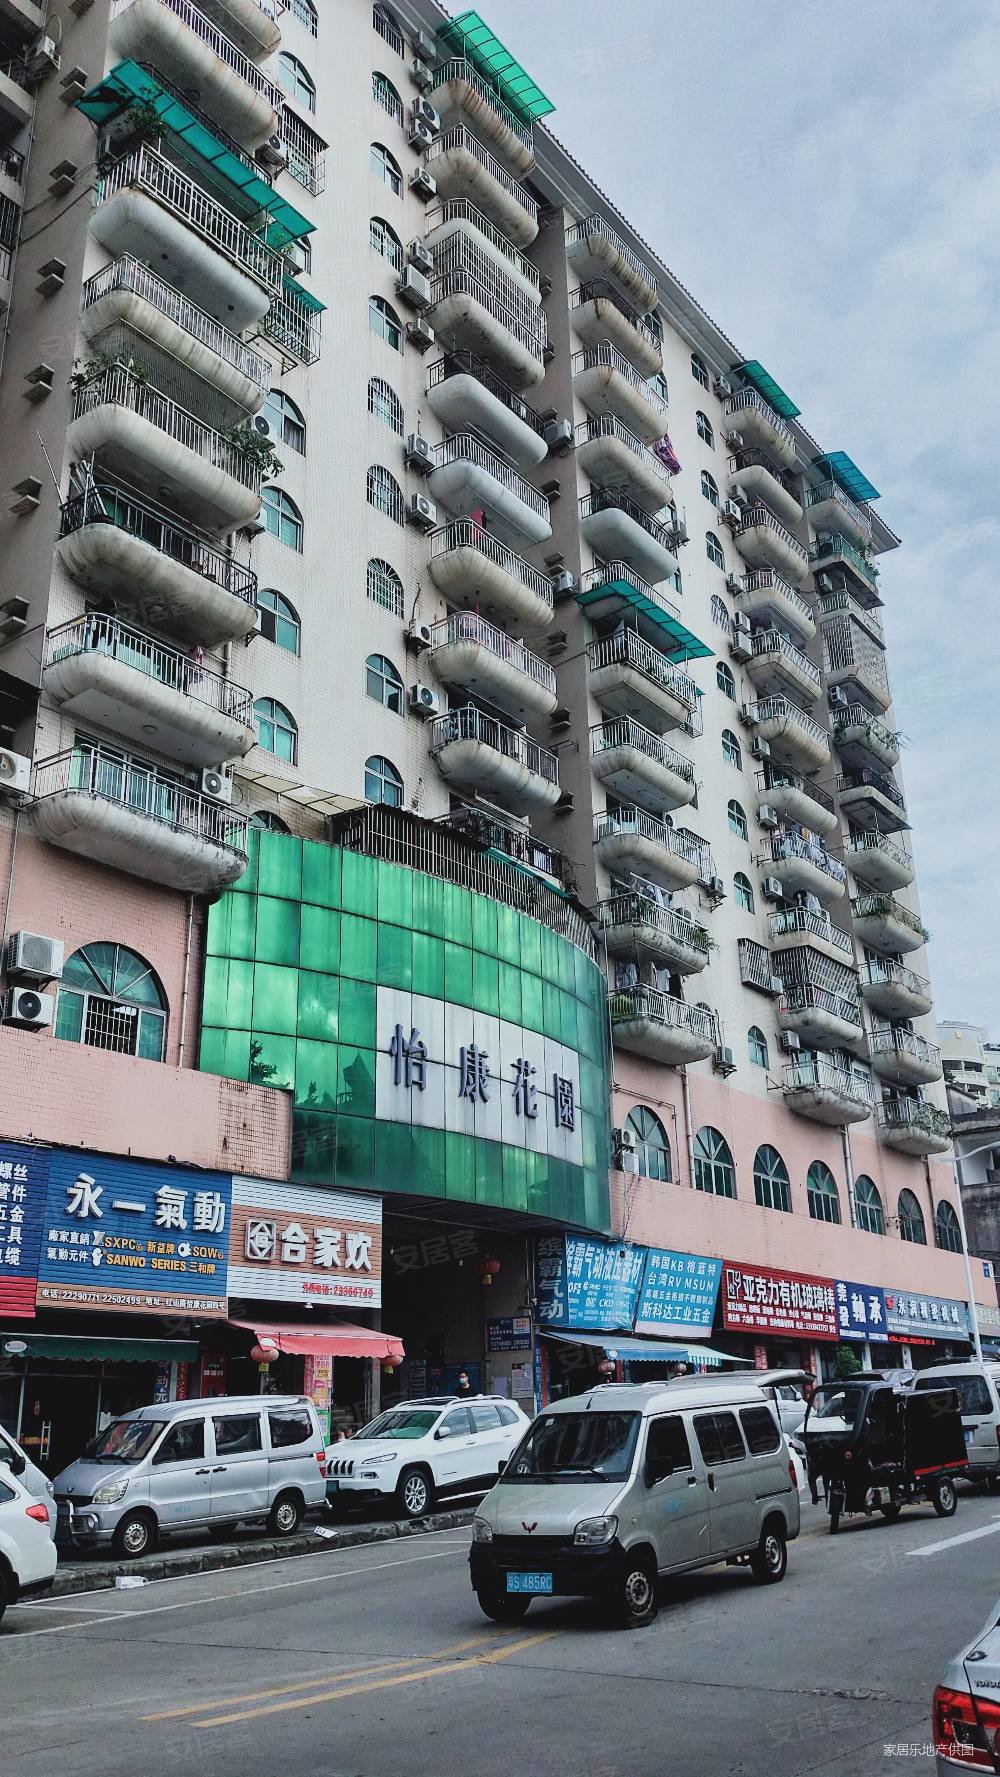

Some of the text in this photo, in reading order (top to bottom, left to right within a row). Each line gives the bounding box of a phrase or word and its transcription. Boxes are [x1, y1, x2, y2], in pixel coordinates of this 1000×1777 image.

[389, 1023, 576, 1133] 怡康花園
[65, 1171, 227, 1234] 永一氣動
[48, 1229, 90, 1245] 廠家直銷
[280, 1222, 373, 1272] 合家欢
[46, 1247, 88, 1263] 氣動元件
[106, 1253, 146, 1268] SANWO
[151, 1258, 187, 1272] SERIES
[651, 1254, 684, 1272] 韩国KB
[648, 1271, 714, 1292] 台湾RV MSUM
[743, 1274, 836, 1313] 亚克力有机玻璃棒
[641, 1301, 711, 1324] 斯科达工业五金
